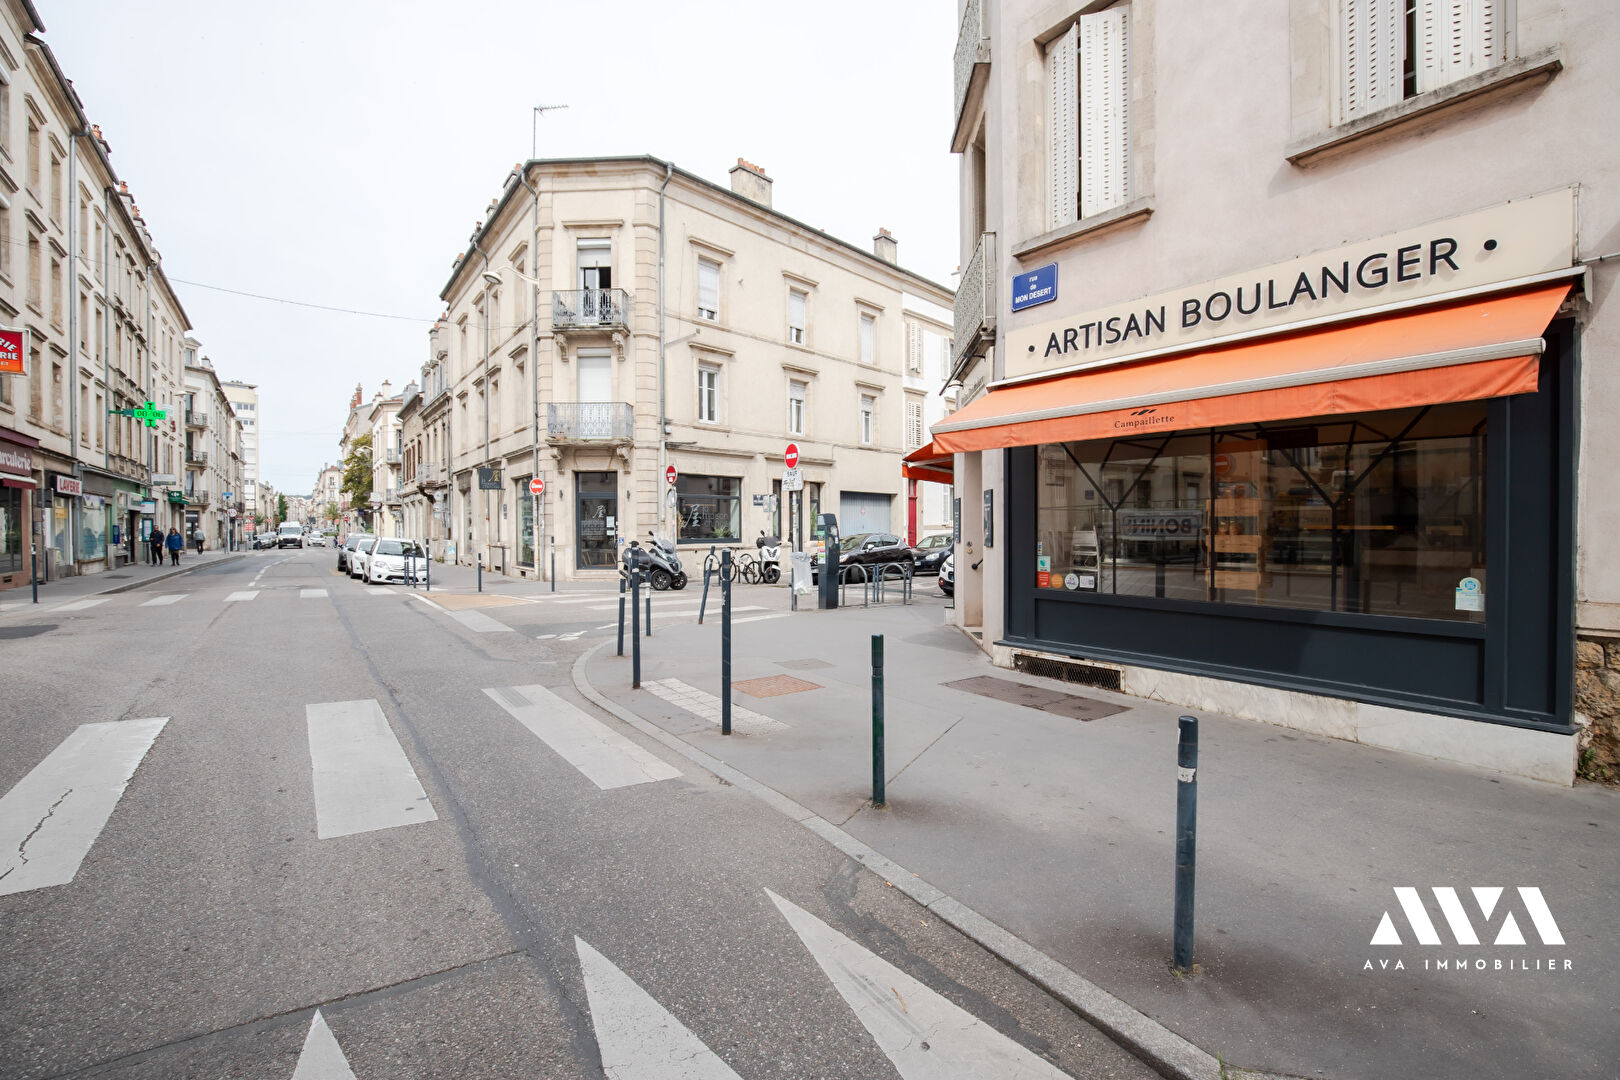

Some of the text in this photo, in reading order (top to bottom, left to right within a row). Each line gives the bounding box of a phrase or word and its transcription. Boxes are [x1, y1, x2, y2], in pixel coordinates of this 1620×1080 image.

[1016, 286, 1052, 304] MON DESERT
[1044, 237, 1460, 358] ARTISAN BOULANGER
[1114, 415, 1175, 428] Campaillette
[60, 478, 80, 494] LAVERIE
